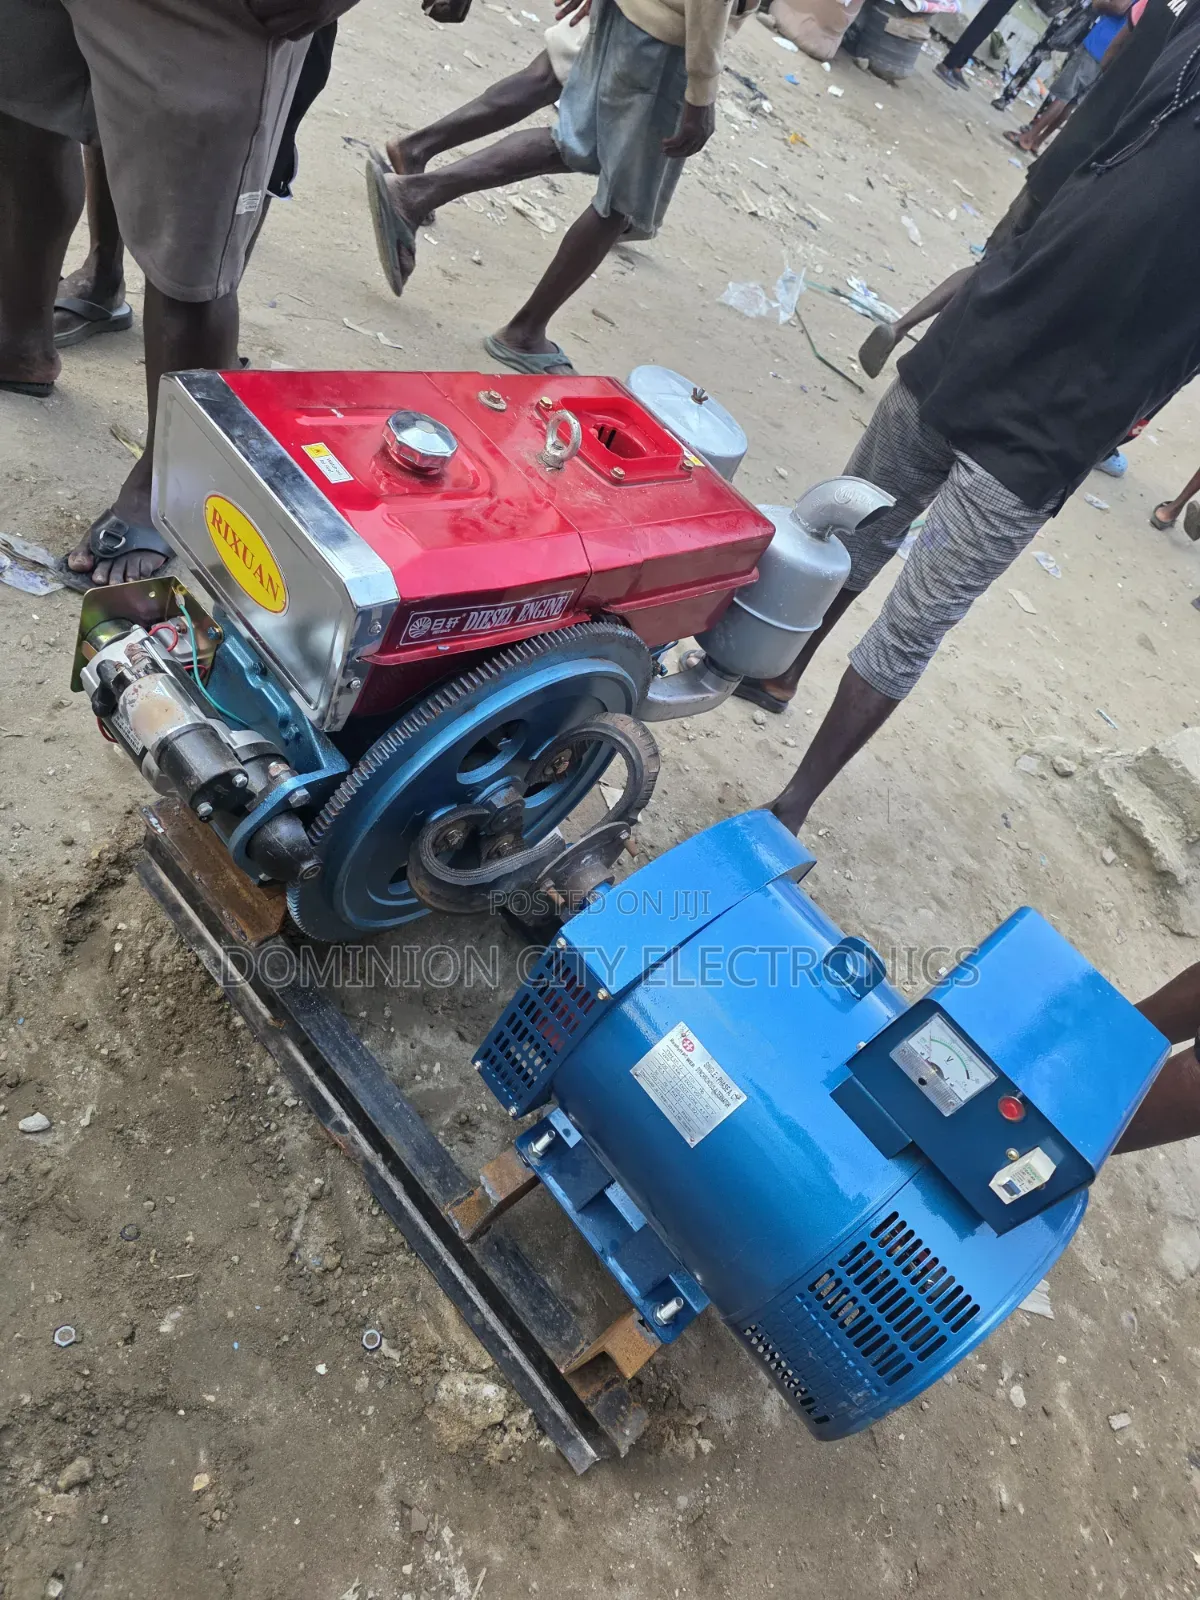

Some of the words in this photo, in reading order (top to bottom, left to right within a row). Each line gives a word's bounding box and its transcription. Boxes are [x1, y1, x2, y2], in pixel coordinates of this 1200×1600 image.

[211, 506, 280, 602] RIXUAN
[462, 605, 517, 632] DIESEL
[515, 595, 568, 623] ENGINE
